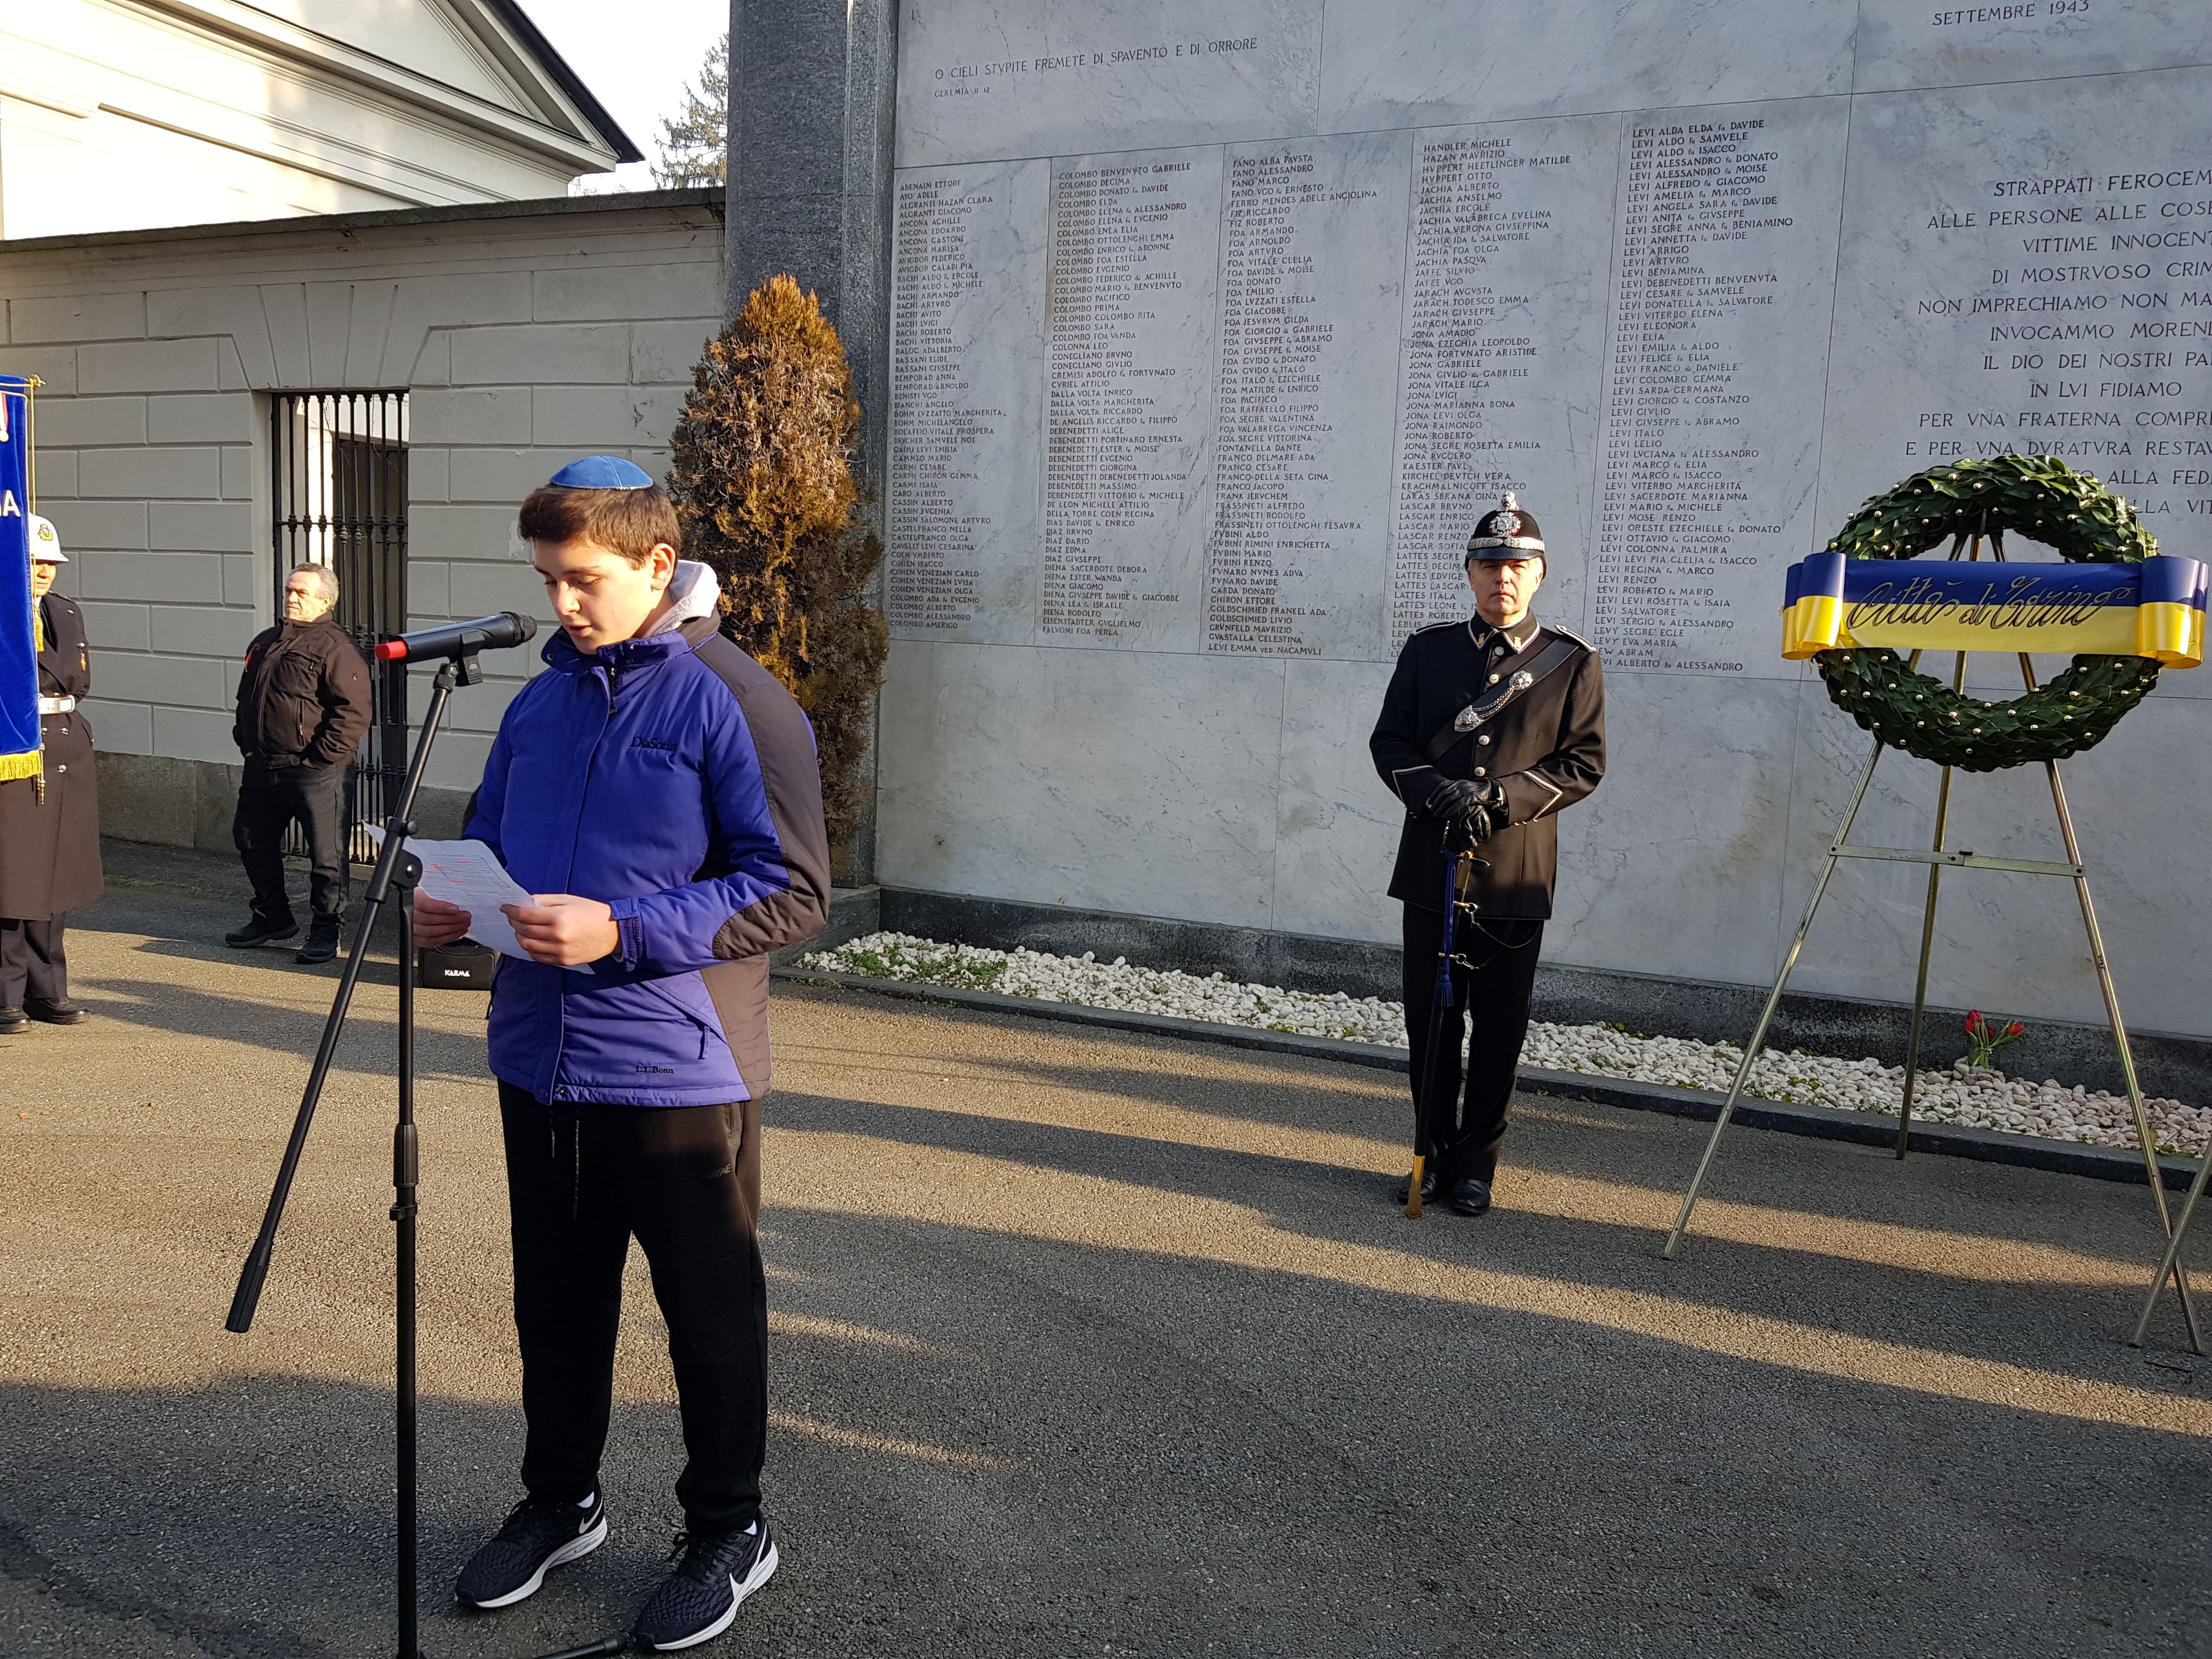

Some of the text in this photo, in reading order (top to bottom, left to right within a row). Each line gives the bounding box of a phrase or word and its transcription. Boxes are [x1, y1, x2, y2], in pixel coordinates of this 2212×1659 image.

[1932, 0, 2089, 25] SETTEMBRE 1943
[935, 38, 1257, 79] O CIELI STVPITE FREMETE DI SPAVENTO E DI ORRORE
[1424, 139, 1511, 152] HANDLER MICHELE
[1632, 139, 1653, 148] LEVI
[1658, 137, 1684, 145] ALDO
[1700, 132, 1748, 143] SAMVELE
[1233, 165, 1313, 177] FANO ALESSANDRO
[1059, 180, 1097, 189] COLOMBO
[1421, 182, 1499, 194] JACHIA ALBERTO
[1994, 178, 2092, 197] STRAPPATI
[1927, 213, 1976, 228] ALLE
[1989, 207, 2082, 226] PERSONE
[2095, 205, 2147, 222] ALLE
[1481, 233, 1530, 242] SALVATORE
[2023, 236, 2097, 253] VITTIME
[1623, 256, 1689, 267] LEVI ARTVRO
[1993, 270, 2007, 284] DI
[2021, 264, 2150, 283] MOSTRVOSO
[1055, 286, 1092, 294] COLOMBO
[1135, 282, 1182, 290] BENVENVTO
[1918, 299, 1964, 315] NON
[1973, 296, 2107, 313] IMPRECHIAMO
[2121, 294, 2168, 309] NON
[1054, 314, 1091, 323] COLOMBO
[1620, 312, 1639, 320] LEVI
[1691, 309, 1723, 318] ELENA
[1412, 330, 1434, 338] JONA
[1990, 325, 2114, 341] INVOCAMMO
[1983, 352, 2212, 370] IL DIO DEI NOSTRI PA
[2030, 381, 2182, 398] IN LVI FIDIAMO
[1920, 411, 2212, 427] PER VNA FRATERNA COMPR
[1906, 442, 1916, 455] E
[1929, 442, 1962, 455] PER
[1977, 442, 2013, 454] VNA
[2027, 442, 2131, 455] DVRATVRA
[2107, 470, 2158, 484] ALLA
[2172, 470, 2212, 484] FED
[1847, 576, 2137, 631] Città di Torino
[1643, 639, 1676, 647] MARIA
